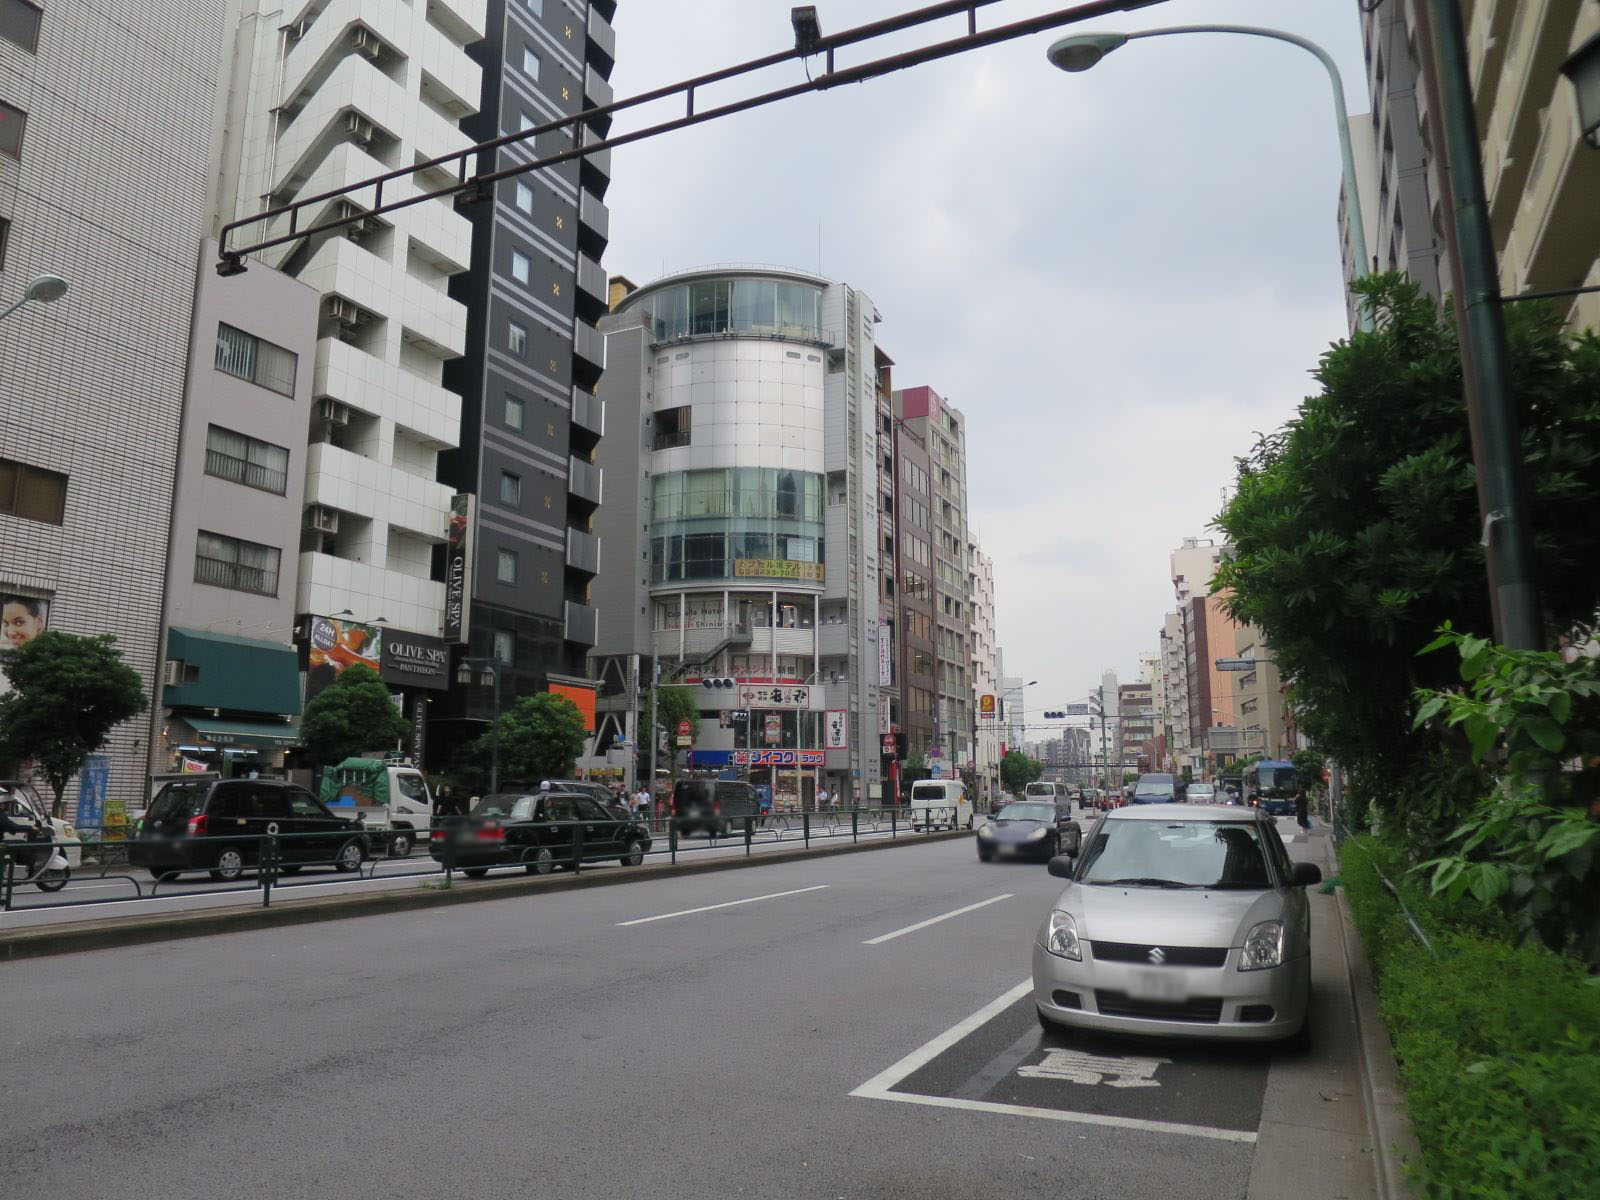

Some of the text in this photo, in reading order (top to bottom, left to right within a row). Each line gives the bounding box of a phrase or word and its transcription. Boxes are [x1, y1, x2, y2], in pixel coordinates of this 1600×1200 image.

[450, 556, 463, 627] OLIVE SPA
[319, 623, 335, 638] 24H
[390, 642, 424, 659] OLIVE
[427, 649, 445, 663] SPA
